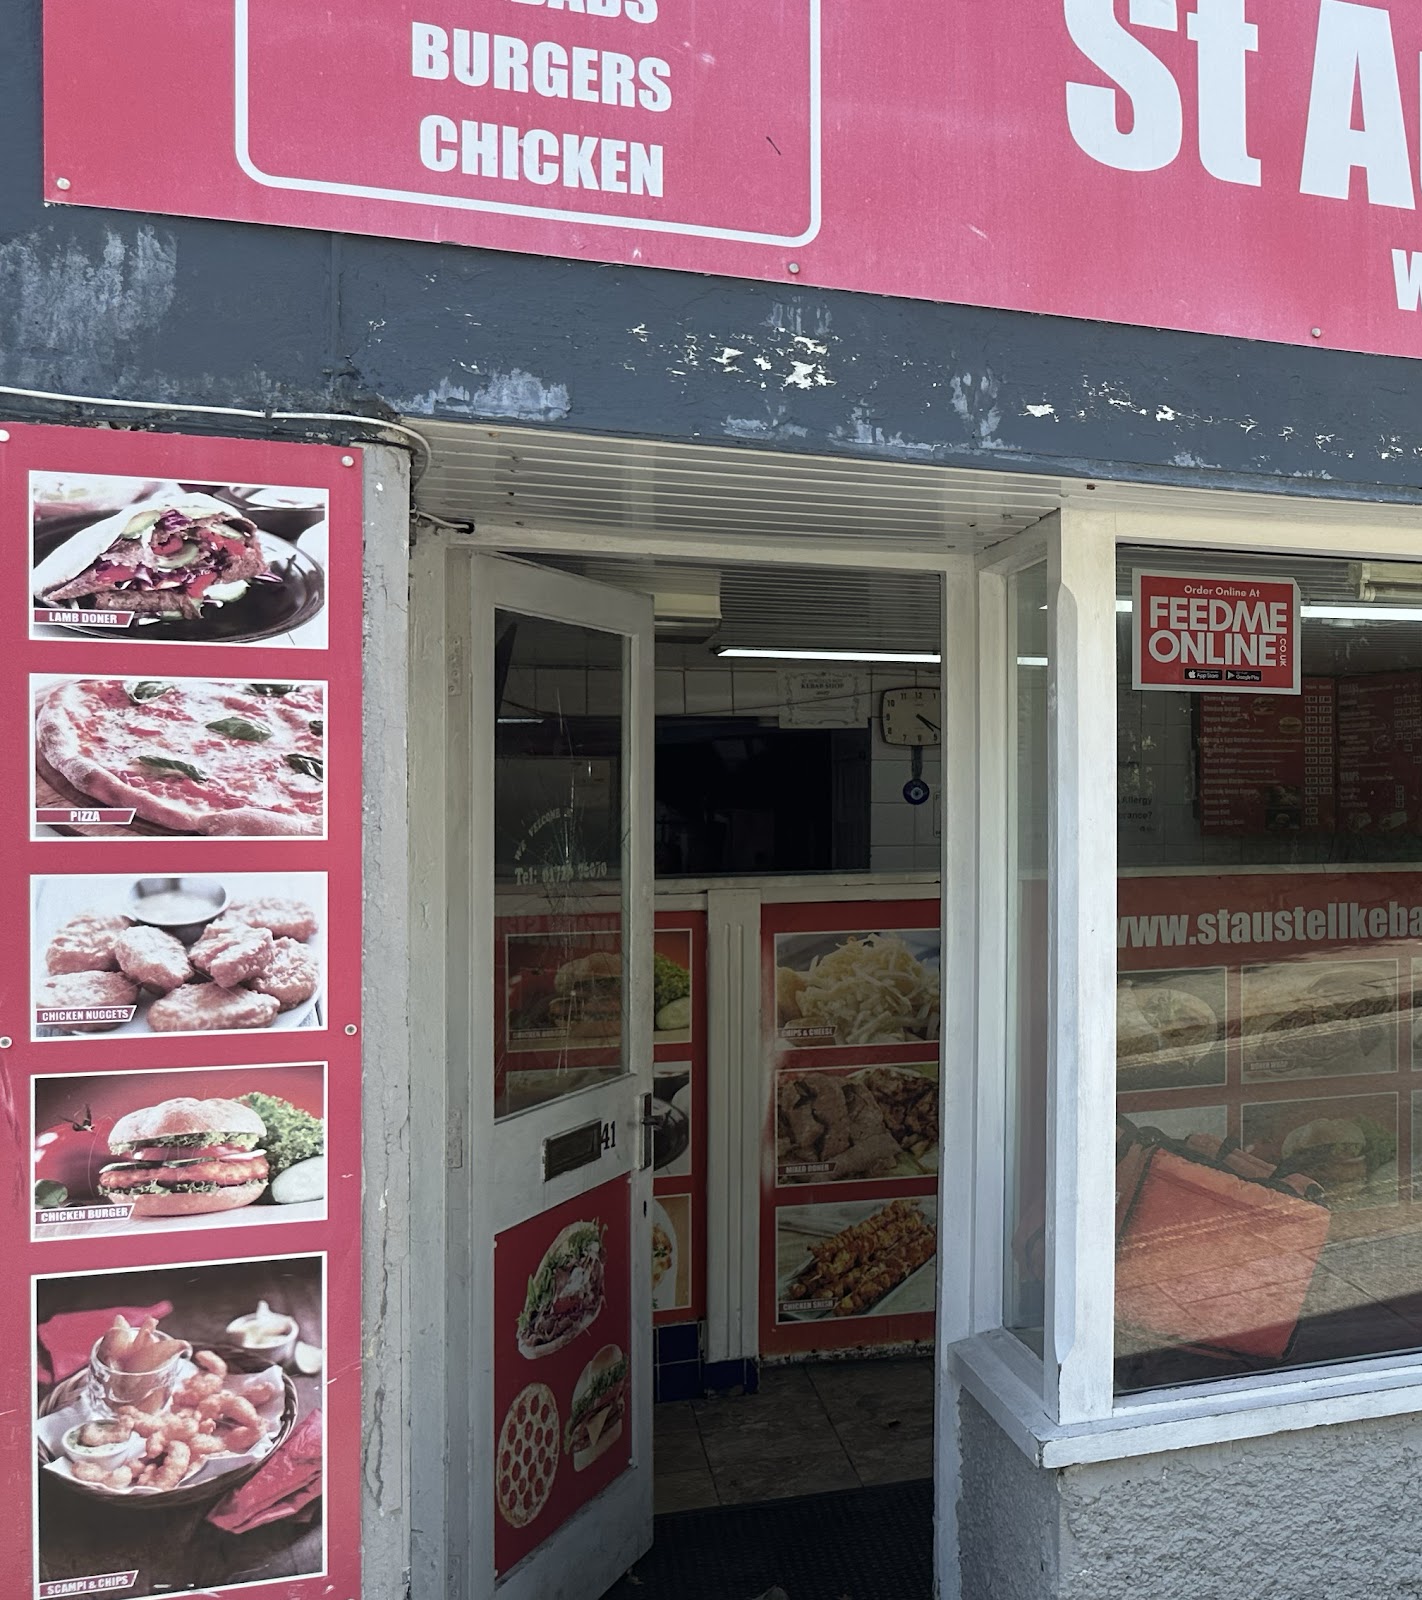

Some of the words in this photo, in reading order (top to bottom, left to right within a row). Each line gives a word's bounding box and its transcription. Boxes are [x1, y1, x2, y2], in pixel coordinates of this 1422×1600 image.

[412, 21, 672, 112] BURGERS
[1064, 0, 1261, 187] St
[419, 114, 664, 198] CHICKEN
[1184, 585, 1213, 596] Order
[1216, 586, 1246, 597] Online
[1249, 588, 1260, 598] At
[48, 612, 79, 624] LAMB
[81, 612, 118, 625] DONER
[1150, 595, 1288, 635] FEEDME
[1148, 629, 1277, 667] ONLINE
[70, 810, 101, 822] PIZZA
[515, 867, 537, 886] Tel:
[42, 1010, 84, 1022] CHICKEN
[86, 1008, 129, 1020] NUGGETS
[808, 1028, 833, 1036] CHEESE
[601, 1121, 616, 1150] 41
[41, 1209, 87, 1222] CHICKEN
[88, 1206, 128, 1219] BURGER
[783, 1302, 812, 1311] CHICKEN
[47, 1580, 87, 1595] SCAMPI
[89, 1579, 97, 1588] &
[98, 1573, 129, 1587] CHIPS
